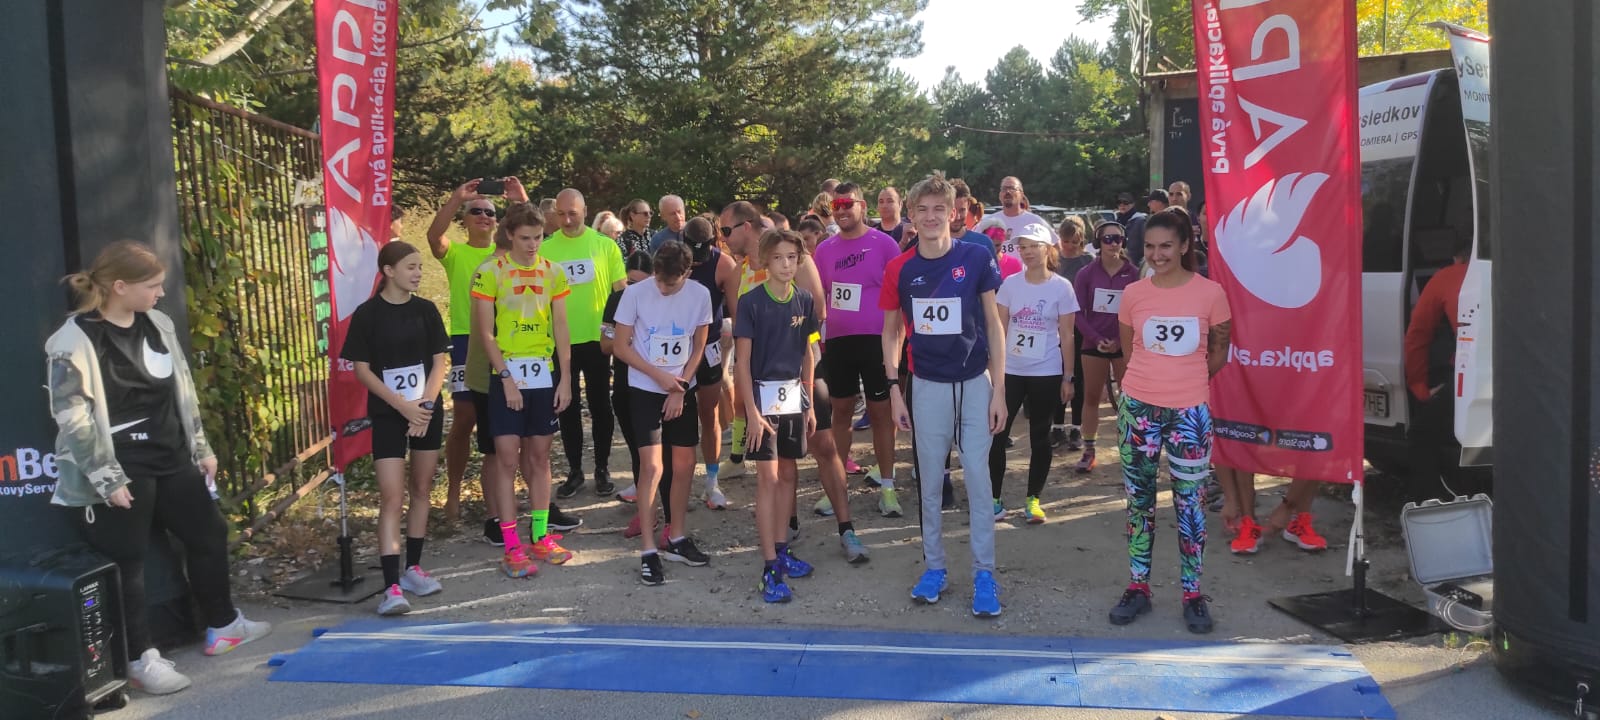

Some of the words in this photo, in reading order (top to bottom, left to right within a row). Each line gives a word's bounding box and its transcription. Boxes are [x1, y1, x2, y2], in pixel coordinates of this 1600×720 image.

[326, 0, 377, 204] APP
[368, 61, 389, 155] aplikácia,
[1401, 131, 1418, 141] GPS
[369, 160, 388, 206] Prvá
[1001, 243, 1014, 254] 38
[567, 263, 586, 276] 13
[835, 287, 852, 301] 30
[1106, 294, 1115, 305] 7
[922, 305, 950, 322] 40
[1155, 324, 1185, 342] 39
[1016, 334, 1035, 348] 21
[661, 341, 682, 356] 16
[712, 342, 721, 355] 1
[451, 370, 465, 383] 28
[519, 362, 541, 378] 19
[394, 373, 418, 390] 20
[777, 387, 787, 402] 8
[130, 432, 149, 440] TM
